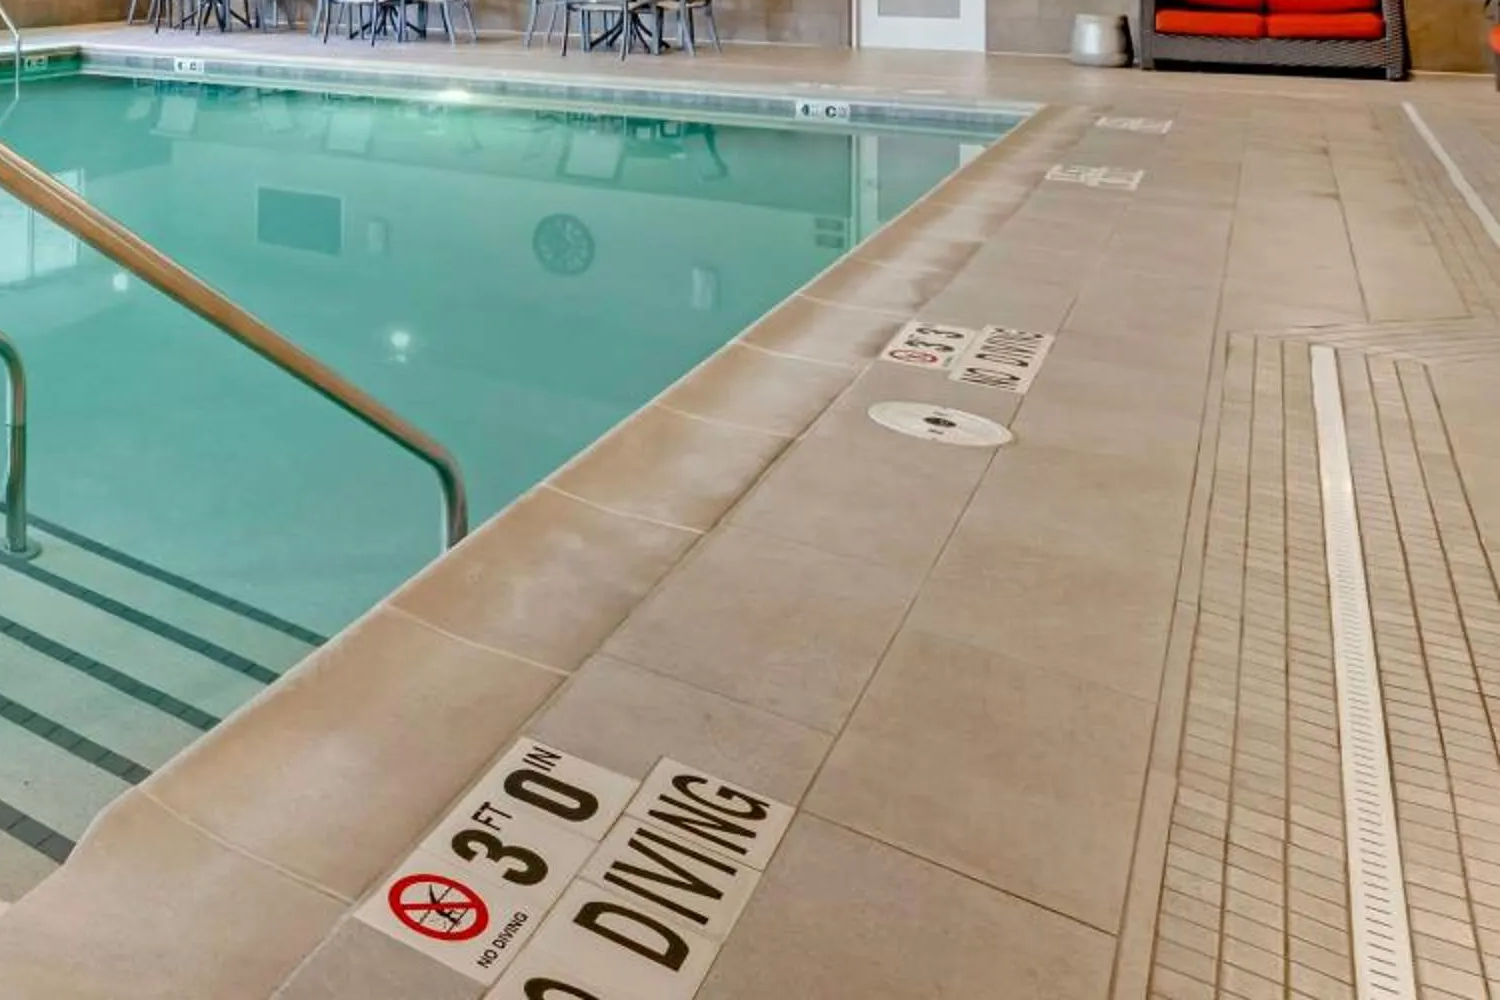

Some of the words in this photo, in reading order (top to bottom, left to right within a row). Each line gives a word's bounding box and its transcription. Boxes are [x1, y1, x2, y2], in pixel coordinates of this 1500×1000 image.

[522, 745, 563, 772] IN
[470, 800, 514, 832] FT
[503, 768, 599, 823] 0
[450, 828, 549, 887] 3
[572, 774, 771, 973] DIVING
[476, 947, 499, 970] NO
[494, 911, 529, 952] DIVING
